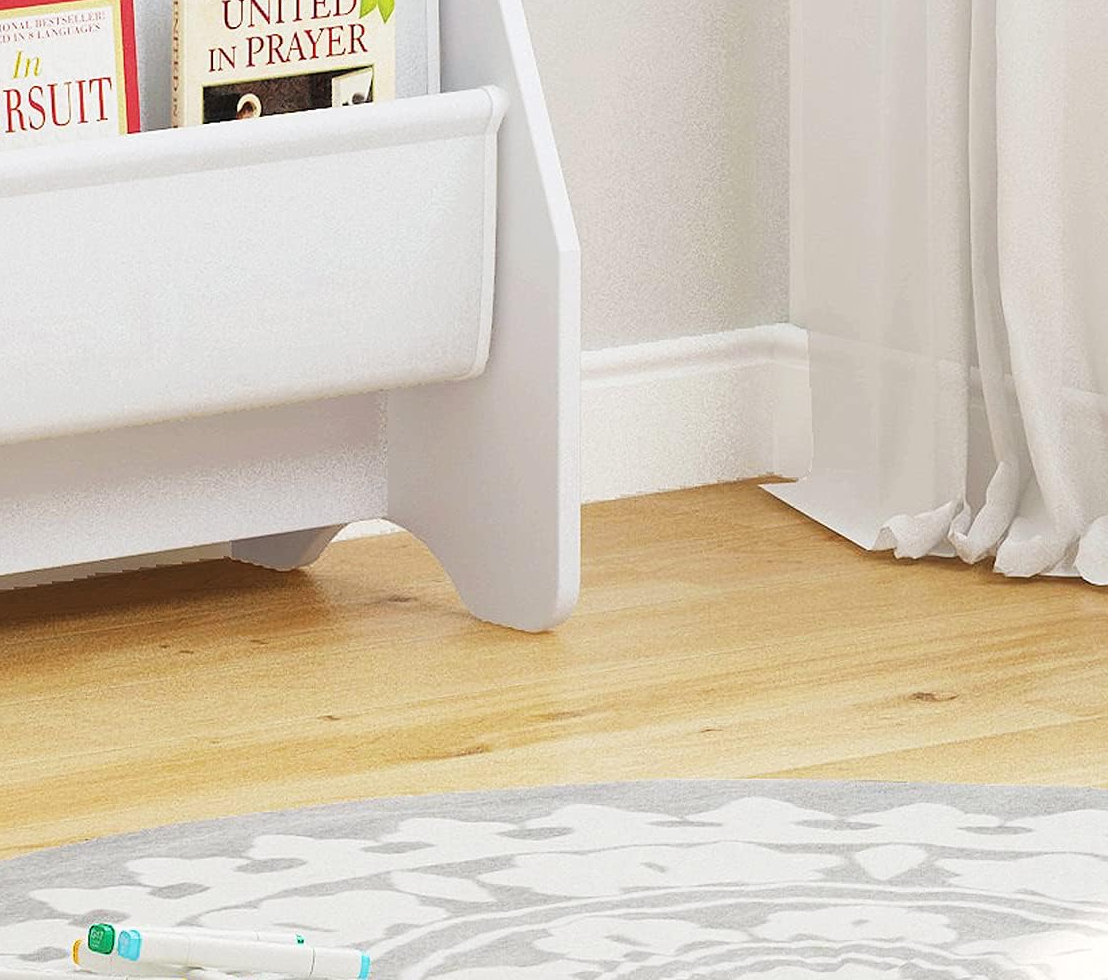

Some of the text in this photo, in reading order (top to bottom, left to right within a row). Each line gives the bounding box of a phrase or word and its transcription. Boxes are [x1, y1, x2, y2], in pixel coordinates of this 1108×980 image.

[35, 11, 105, 28] BESTSELLER!
[14, 31, 26, 42] IN
[36, 23, 100, 40] LANGUAGES
[208, 24, 368, 72] IN PRAYER
[12, 51, 41, 79] In
